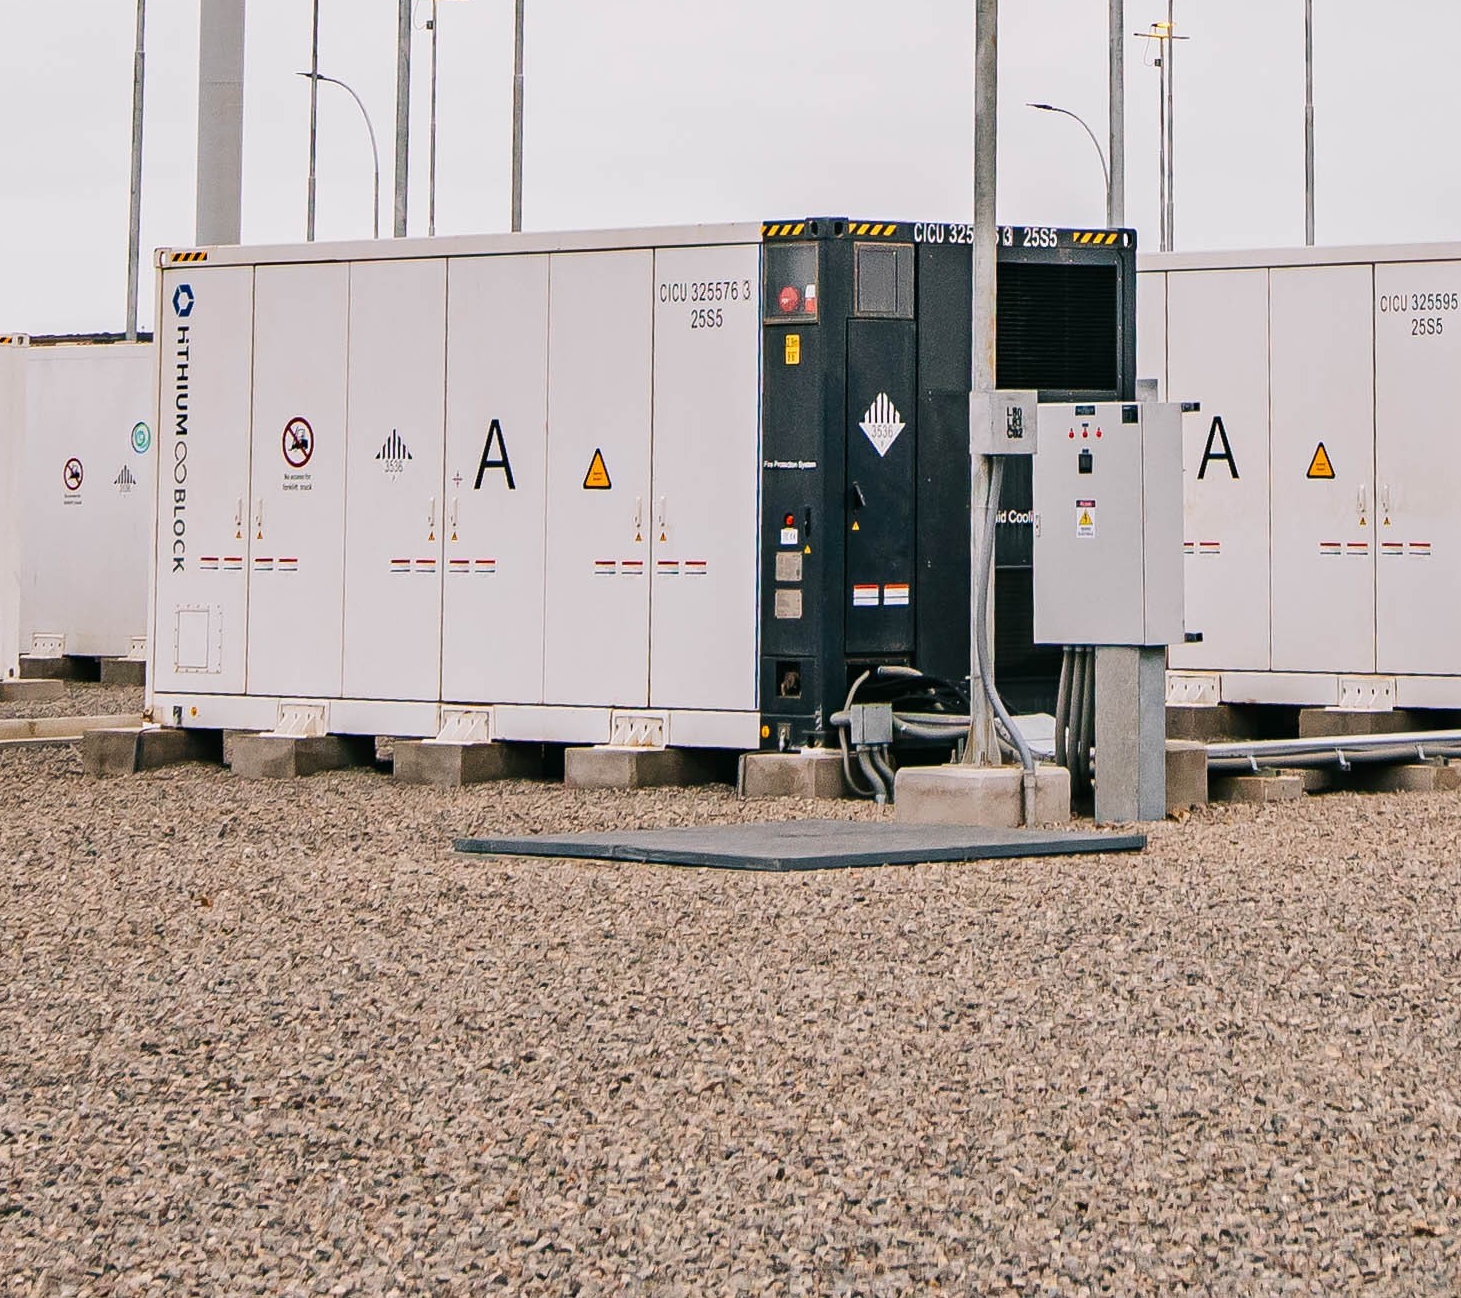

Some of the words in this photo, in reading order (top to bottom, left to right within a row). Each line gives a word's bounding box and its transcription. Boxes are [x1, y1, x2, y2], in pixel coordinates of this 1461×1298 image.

[913, 222, 945, 243] CICU
[1003, 226, 1013, 247] 3
[1023, 227, 1058, 248] 25S5
[660, 283, 688, 302] CICU
[691, 281, 739, 301] 325576
[743, 280, 751, 300] 3
[1380, 294, 1408, 312] CICU
[1411, 293, 1458, 311] 325595
[691, 308, 723, 329] 25S5
[1411, 318, 1443, 335] 25S5
[871, 425, 893, 438] 3536
[474, 419, 516, 490] A
[1197, 416, 1239, 480] A
[172, 489, 186, 573] BLOCK
